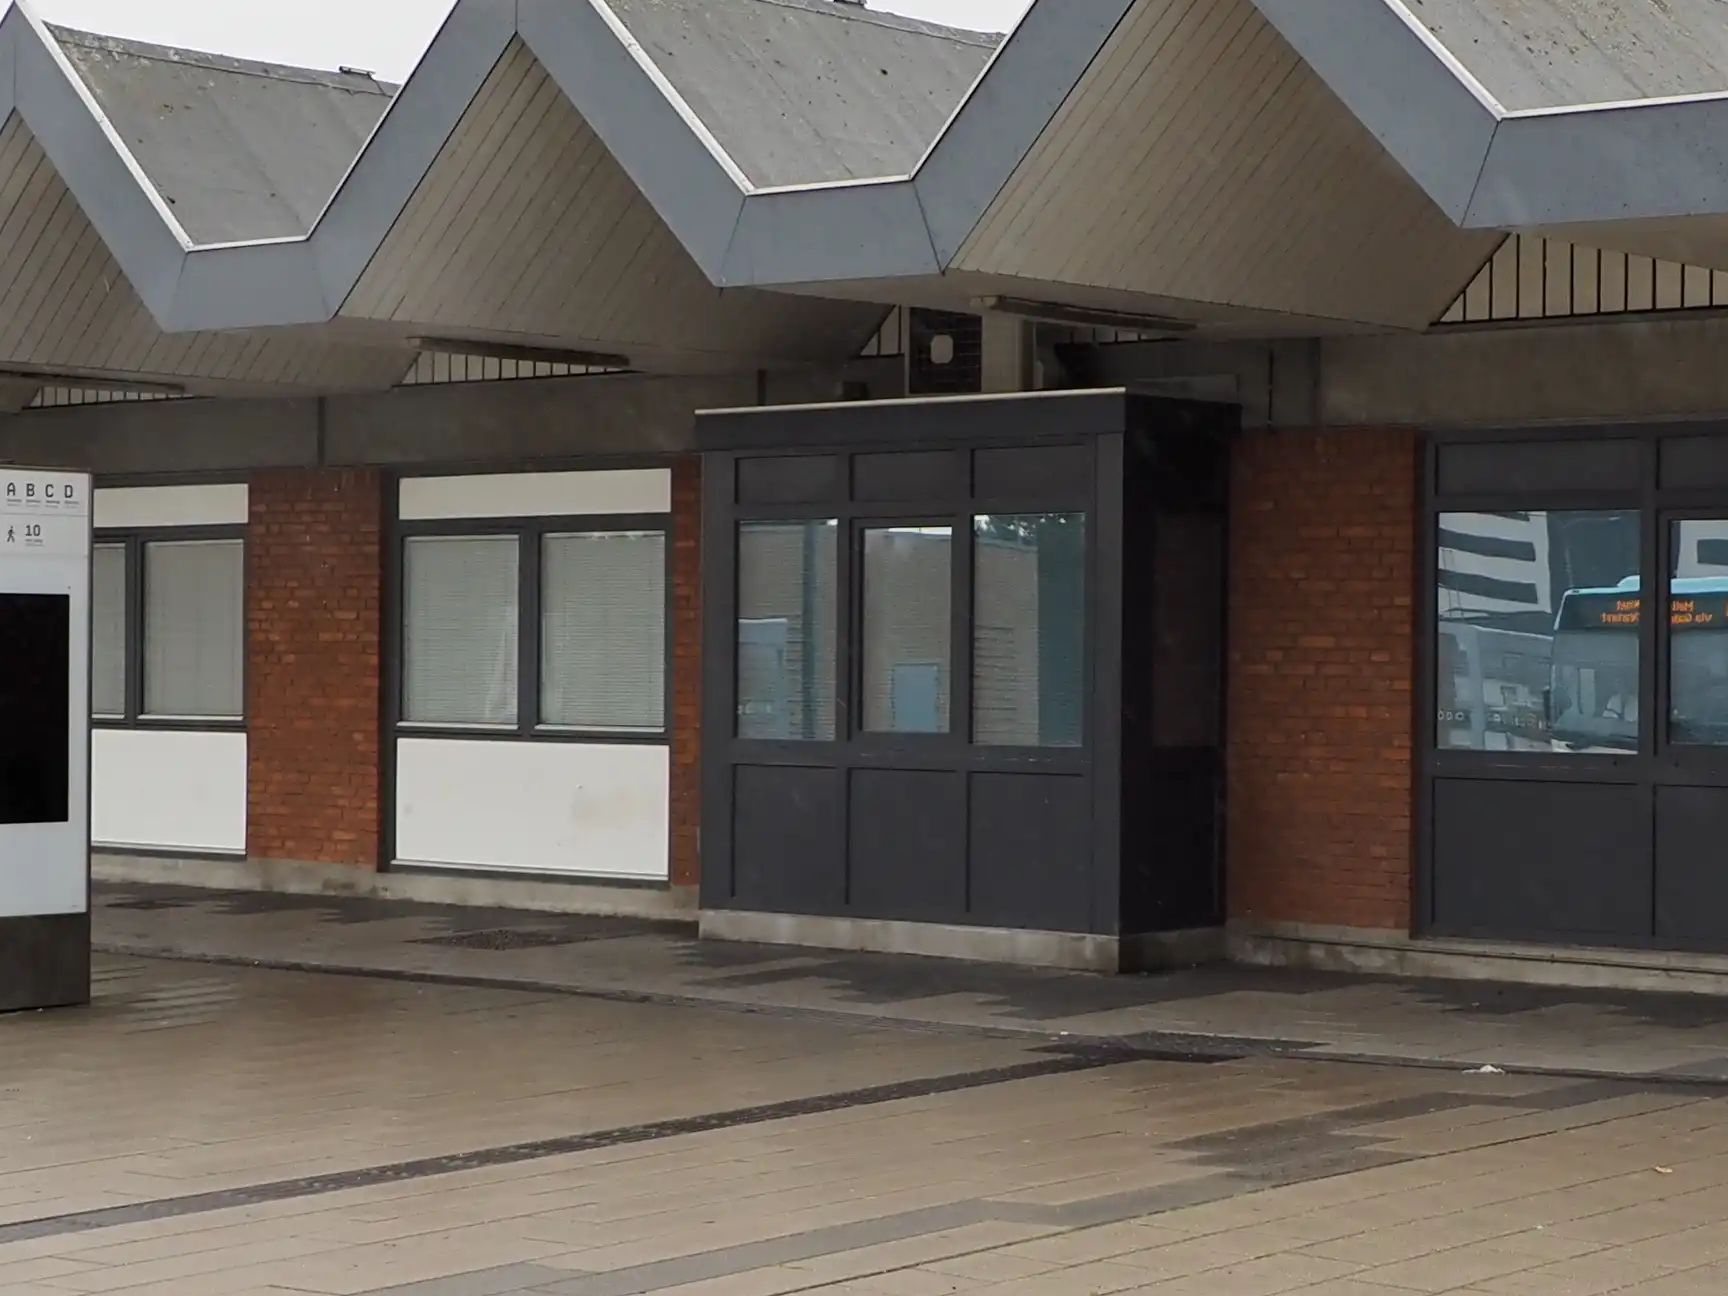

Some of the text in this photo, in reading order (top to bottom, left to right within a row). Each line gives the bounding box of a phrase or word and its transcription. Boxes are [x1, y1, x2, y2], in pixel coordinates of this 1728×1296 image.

[6, 482, 73, 498] A B C D
[25, 524, 41, 537] 10
